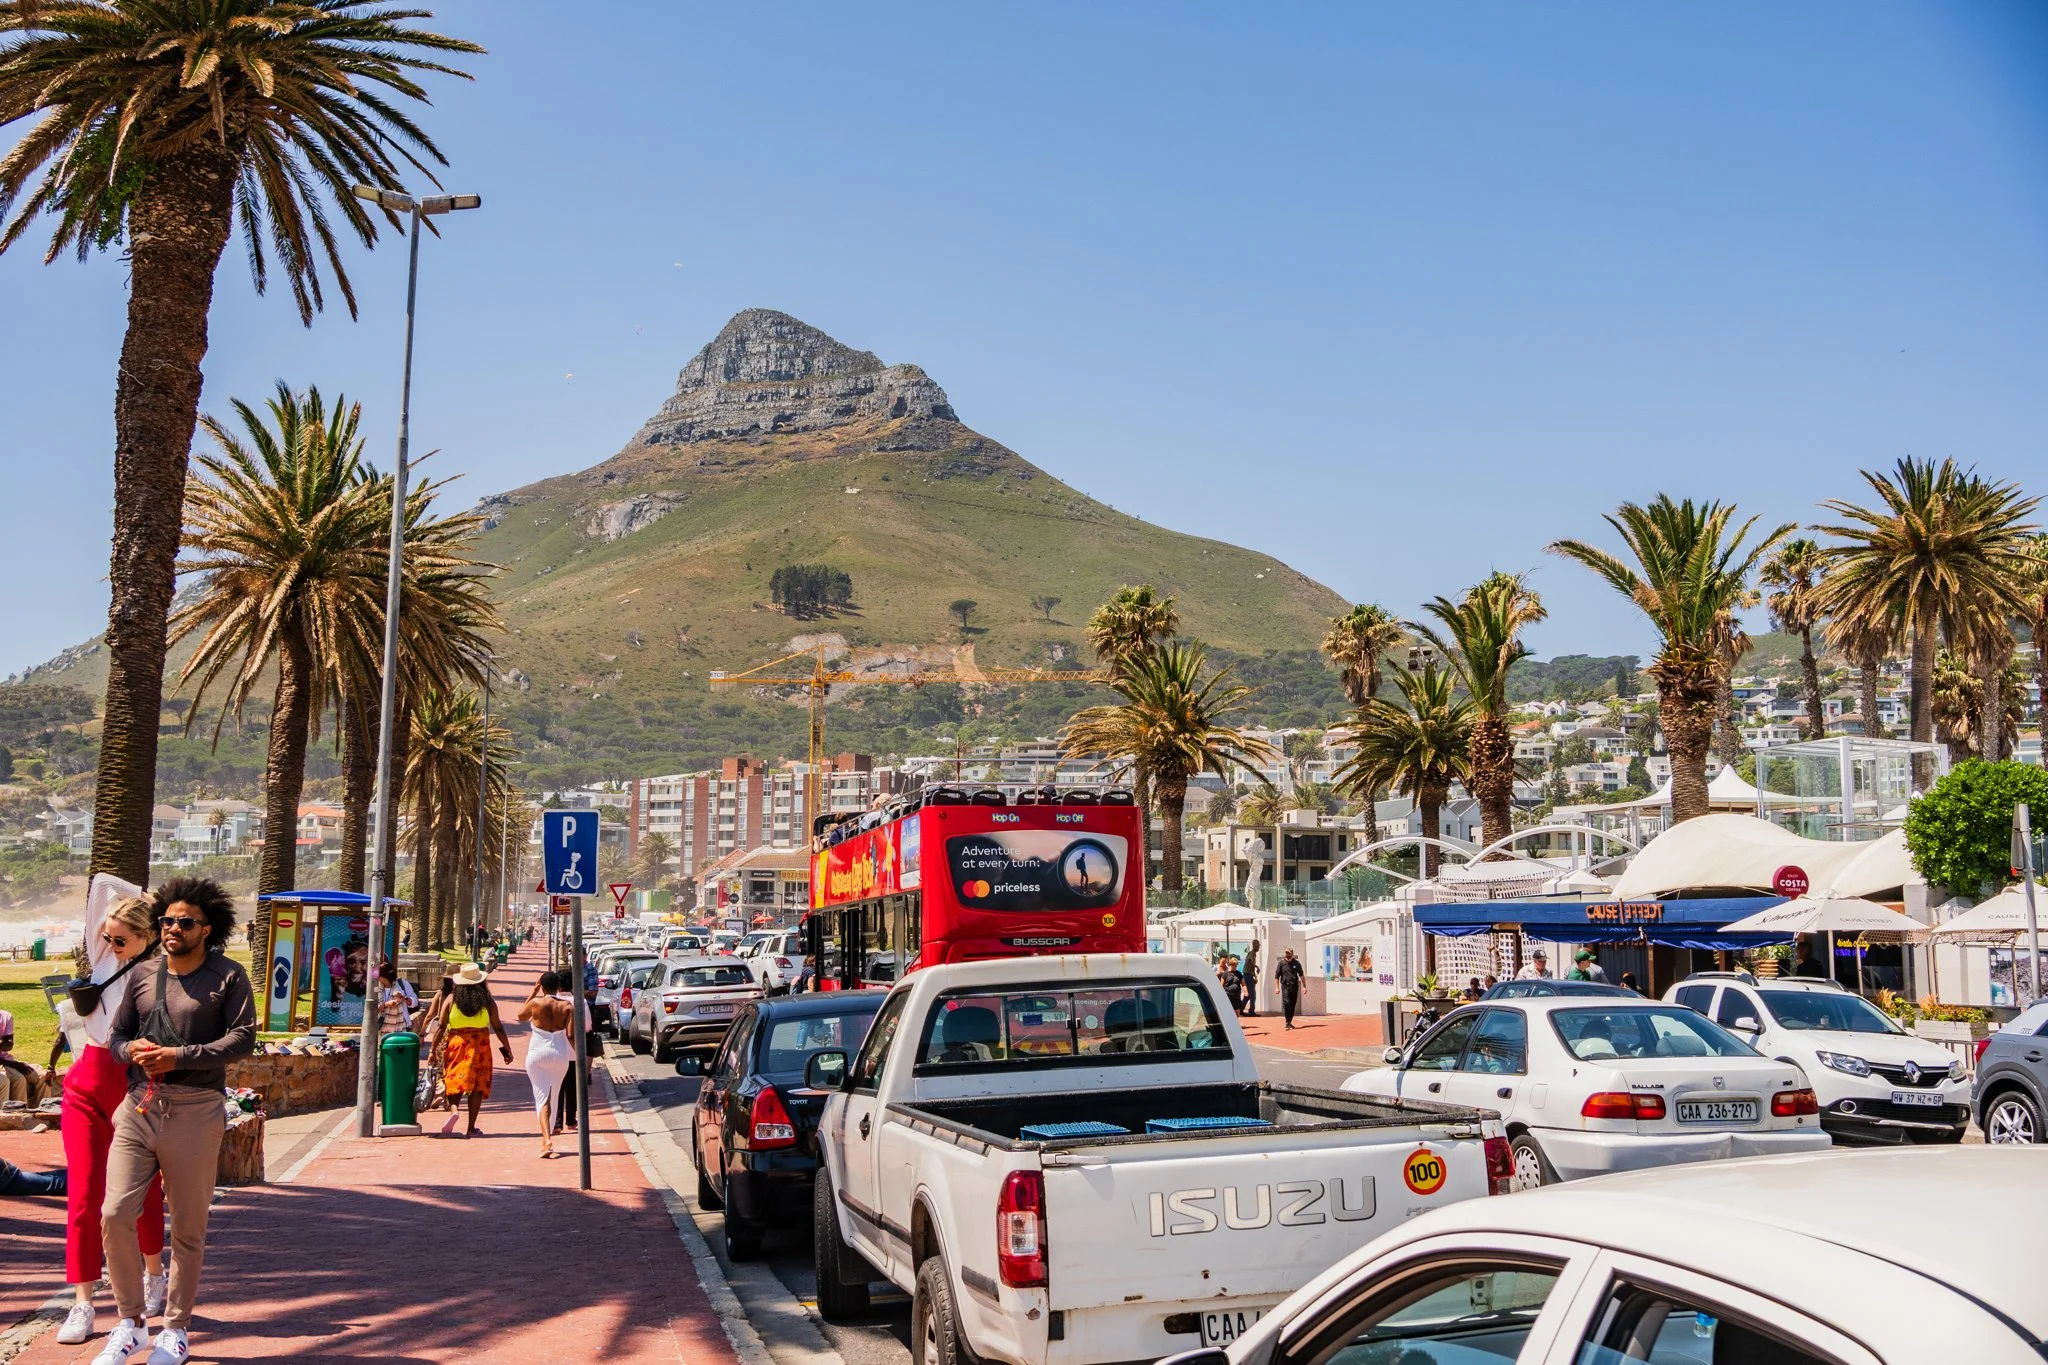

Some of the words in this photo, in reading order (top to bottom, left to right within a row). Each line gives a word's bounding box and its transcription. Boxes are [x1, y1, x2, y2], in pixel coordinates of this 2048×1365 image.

[992, 813, 1007, 822] Hop
[1009, 813, 1020, 822] On
[1056, 813, 1071, 822] Hop
[1072, 813, 1084, 822] Off
[562, 816, 577, 848] P
[961, 846, 1021, 856] Adventure
[962, 860, 975, 869] at
[978, 860, 1008, 870] every
[1012, 858, 1041, 868] turn:
[994, 882, 1041, 895] priceless
[1779, 879, 1807, 888] COSTA
[1585, 904, 1618, 919] CAUSE
[1103, 915, 1115, 924] 100
[1013, 937, 1070, 946] BUSSCAR
[1894, 1093, 1903, 1103] HW
[1906, 1094, 1914, 1104] 37
[1933, 1096, 1941, 1105] GP
[1680, 1104, 1701, 1119] CAA
[1707, 1103, 1751, 1119] 236-279
[1409, 1160, 1439, 1183] 100
[1149, 1175, 1376, 1237] ISUZU
[1206, 1312, 1247, 1341] CAA
